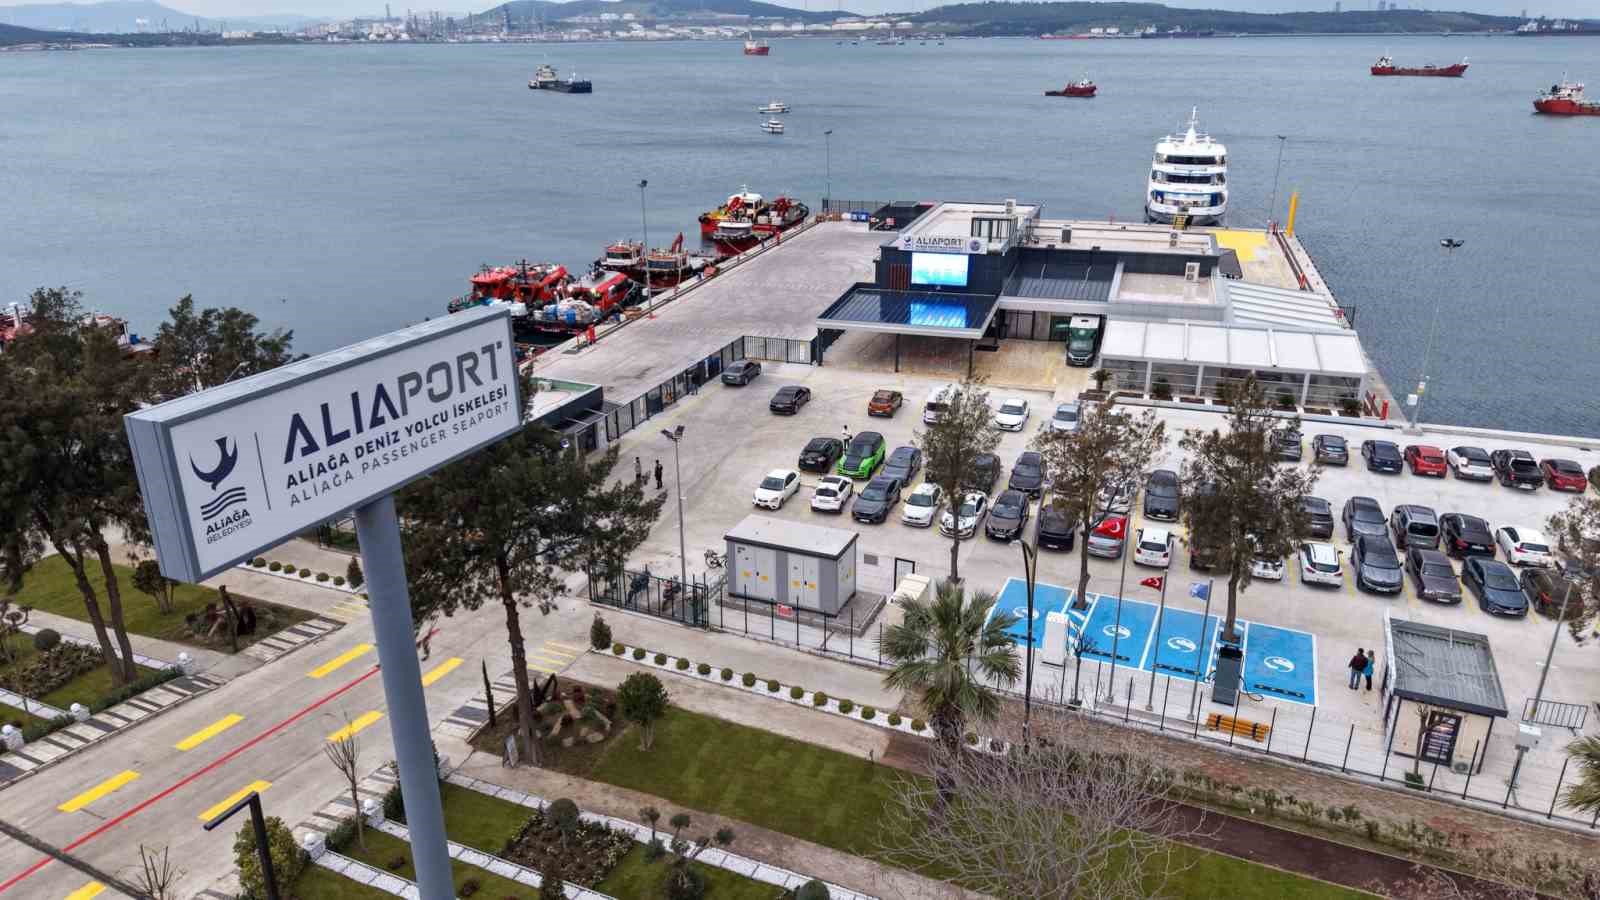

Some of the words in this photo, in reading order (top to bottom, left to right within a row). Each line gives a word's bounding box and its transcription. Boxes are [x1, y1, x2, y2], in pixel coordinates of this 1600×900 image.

[915, 236, 962, 246] ALIAPORT
[284, 342, 499, 464] ALIAPORT
[286, 452, 350, 490] ALİAĞA
[354, 430, 401, 459] DENİZ
[404, 410, 449, 438] YOLCU
[453, 383, 508, 419] İSKELESİ
[290, 470, 355, 508] ALİAĞA
[361, 429, 447, 475] PASSENGER
[451, 401, 509, 435] SEAPORT
[206, 508, 251, 536] ALİAĞA
